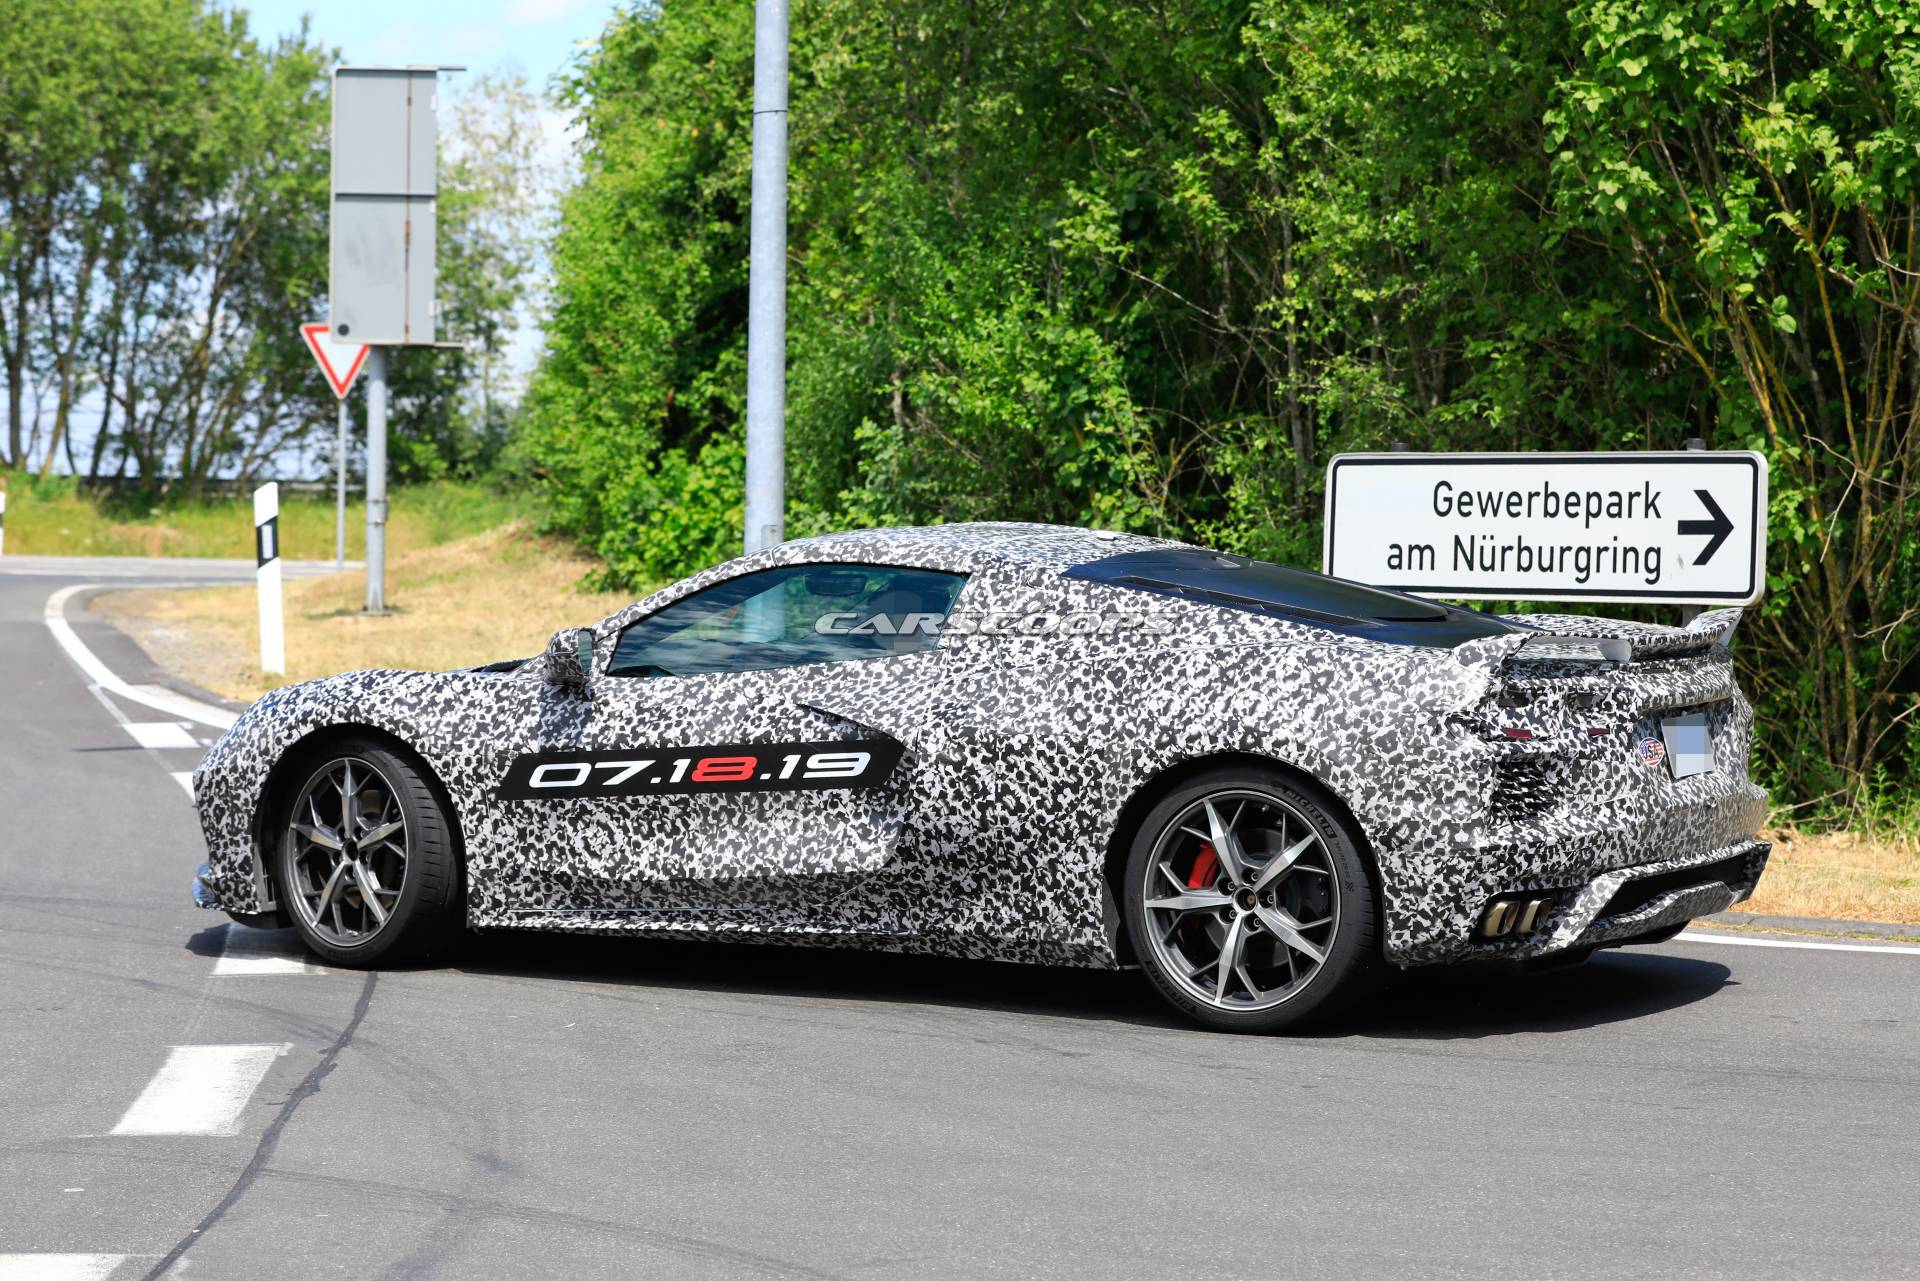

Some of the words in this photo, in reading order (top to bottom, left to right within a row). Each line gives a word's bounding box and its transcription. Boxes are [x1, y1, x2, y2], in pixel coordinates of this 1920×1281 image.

[1433, 480, 1662, 528] Gewerbepark
[1387, 543, 1435, 571] am
[1453, 535, 1661, 585] Nürburgring
[529, 752, 871, 788] 07.18.19
[1640, 743, 1661, 759] USA
[1283, 788, 1336, 837] MICHELIN
